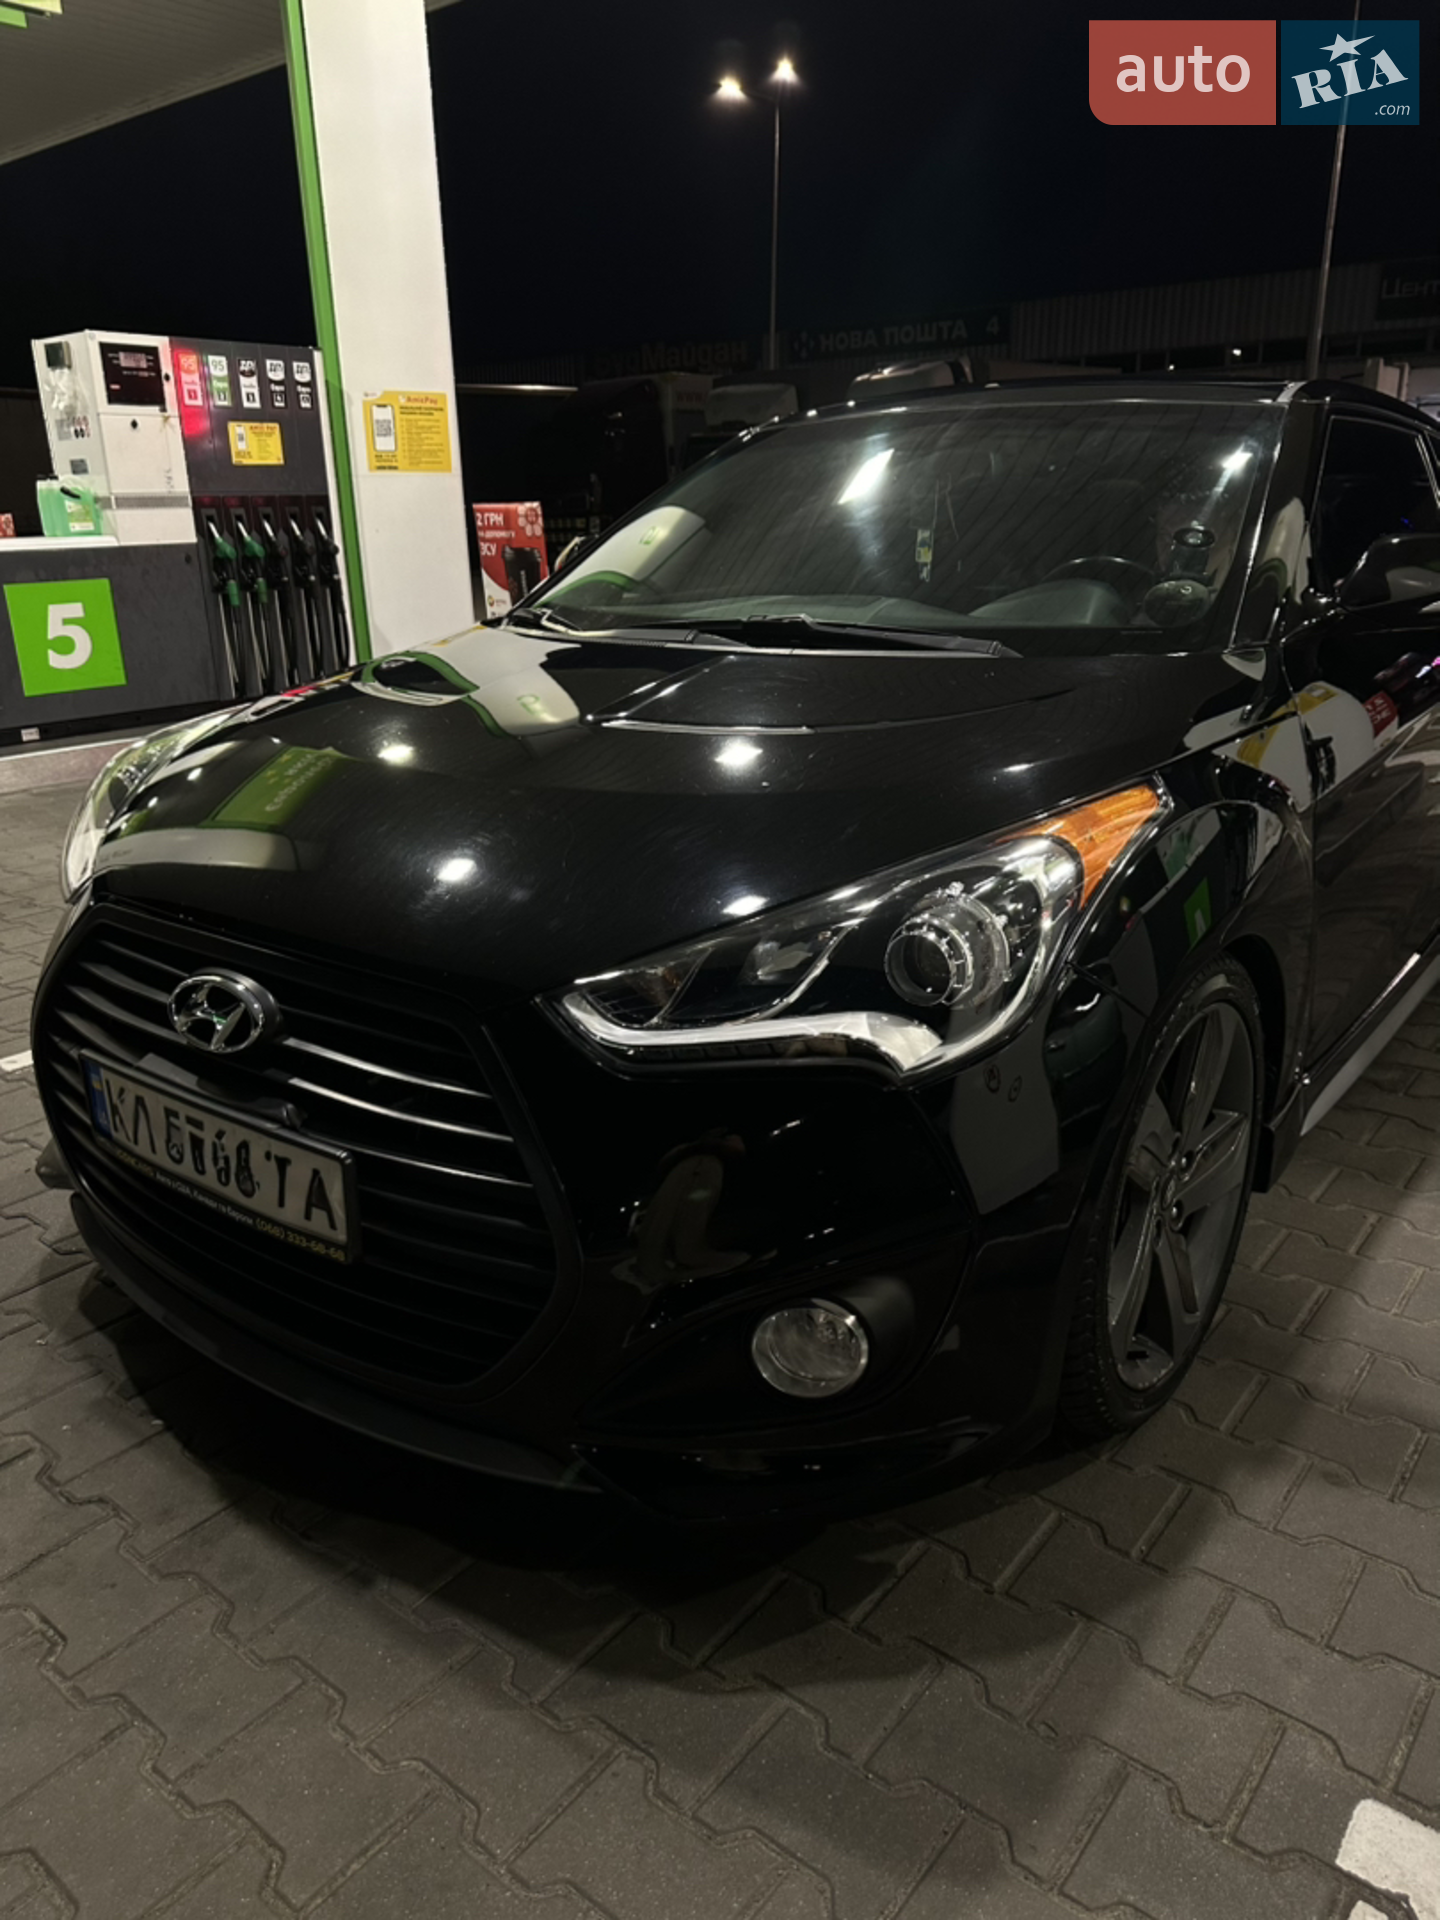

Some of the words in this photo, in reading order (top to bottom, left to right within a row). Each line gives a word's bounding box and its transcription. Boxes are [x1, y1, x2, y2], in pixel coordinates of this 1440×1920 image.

[819, 328, 878, 352] НОВА
[882, 319, 968, 345] ПОШТА
[986, 315, 1000, 336] 4
[211, 360, 224, 371] 95
[484, 512, 504, 526] ГРН
[47, 603, 93, 669] 5
